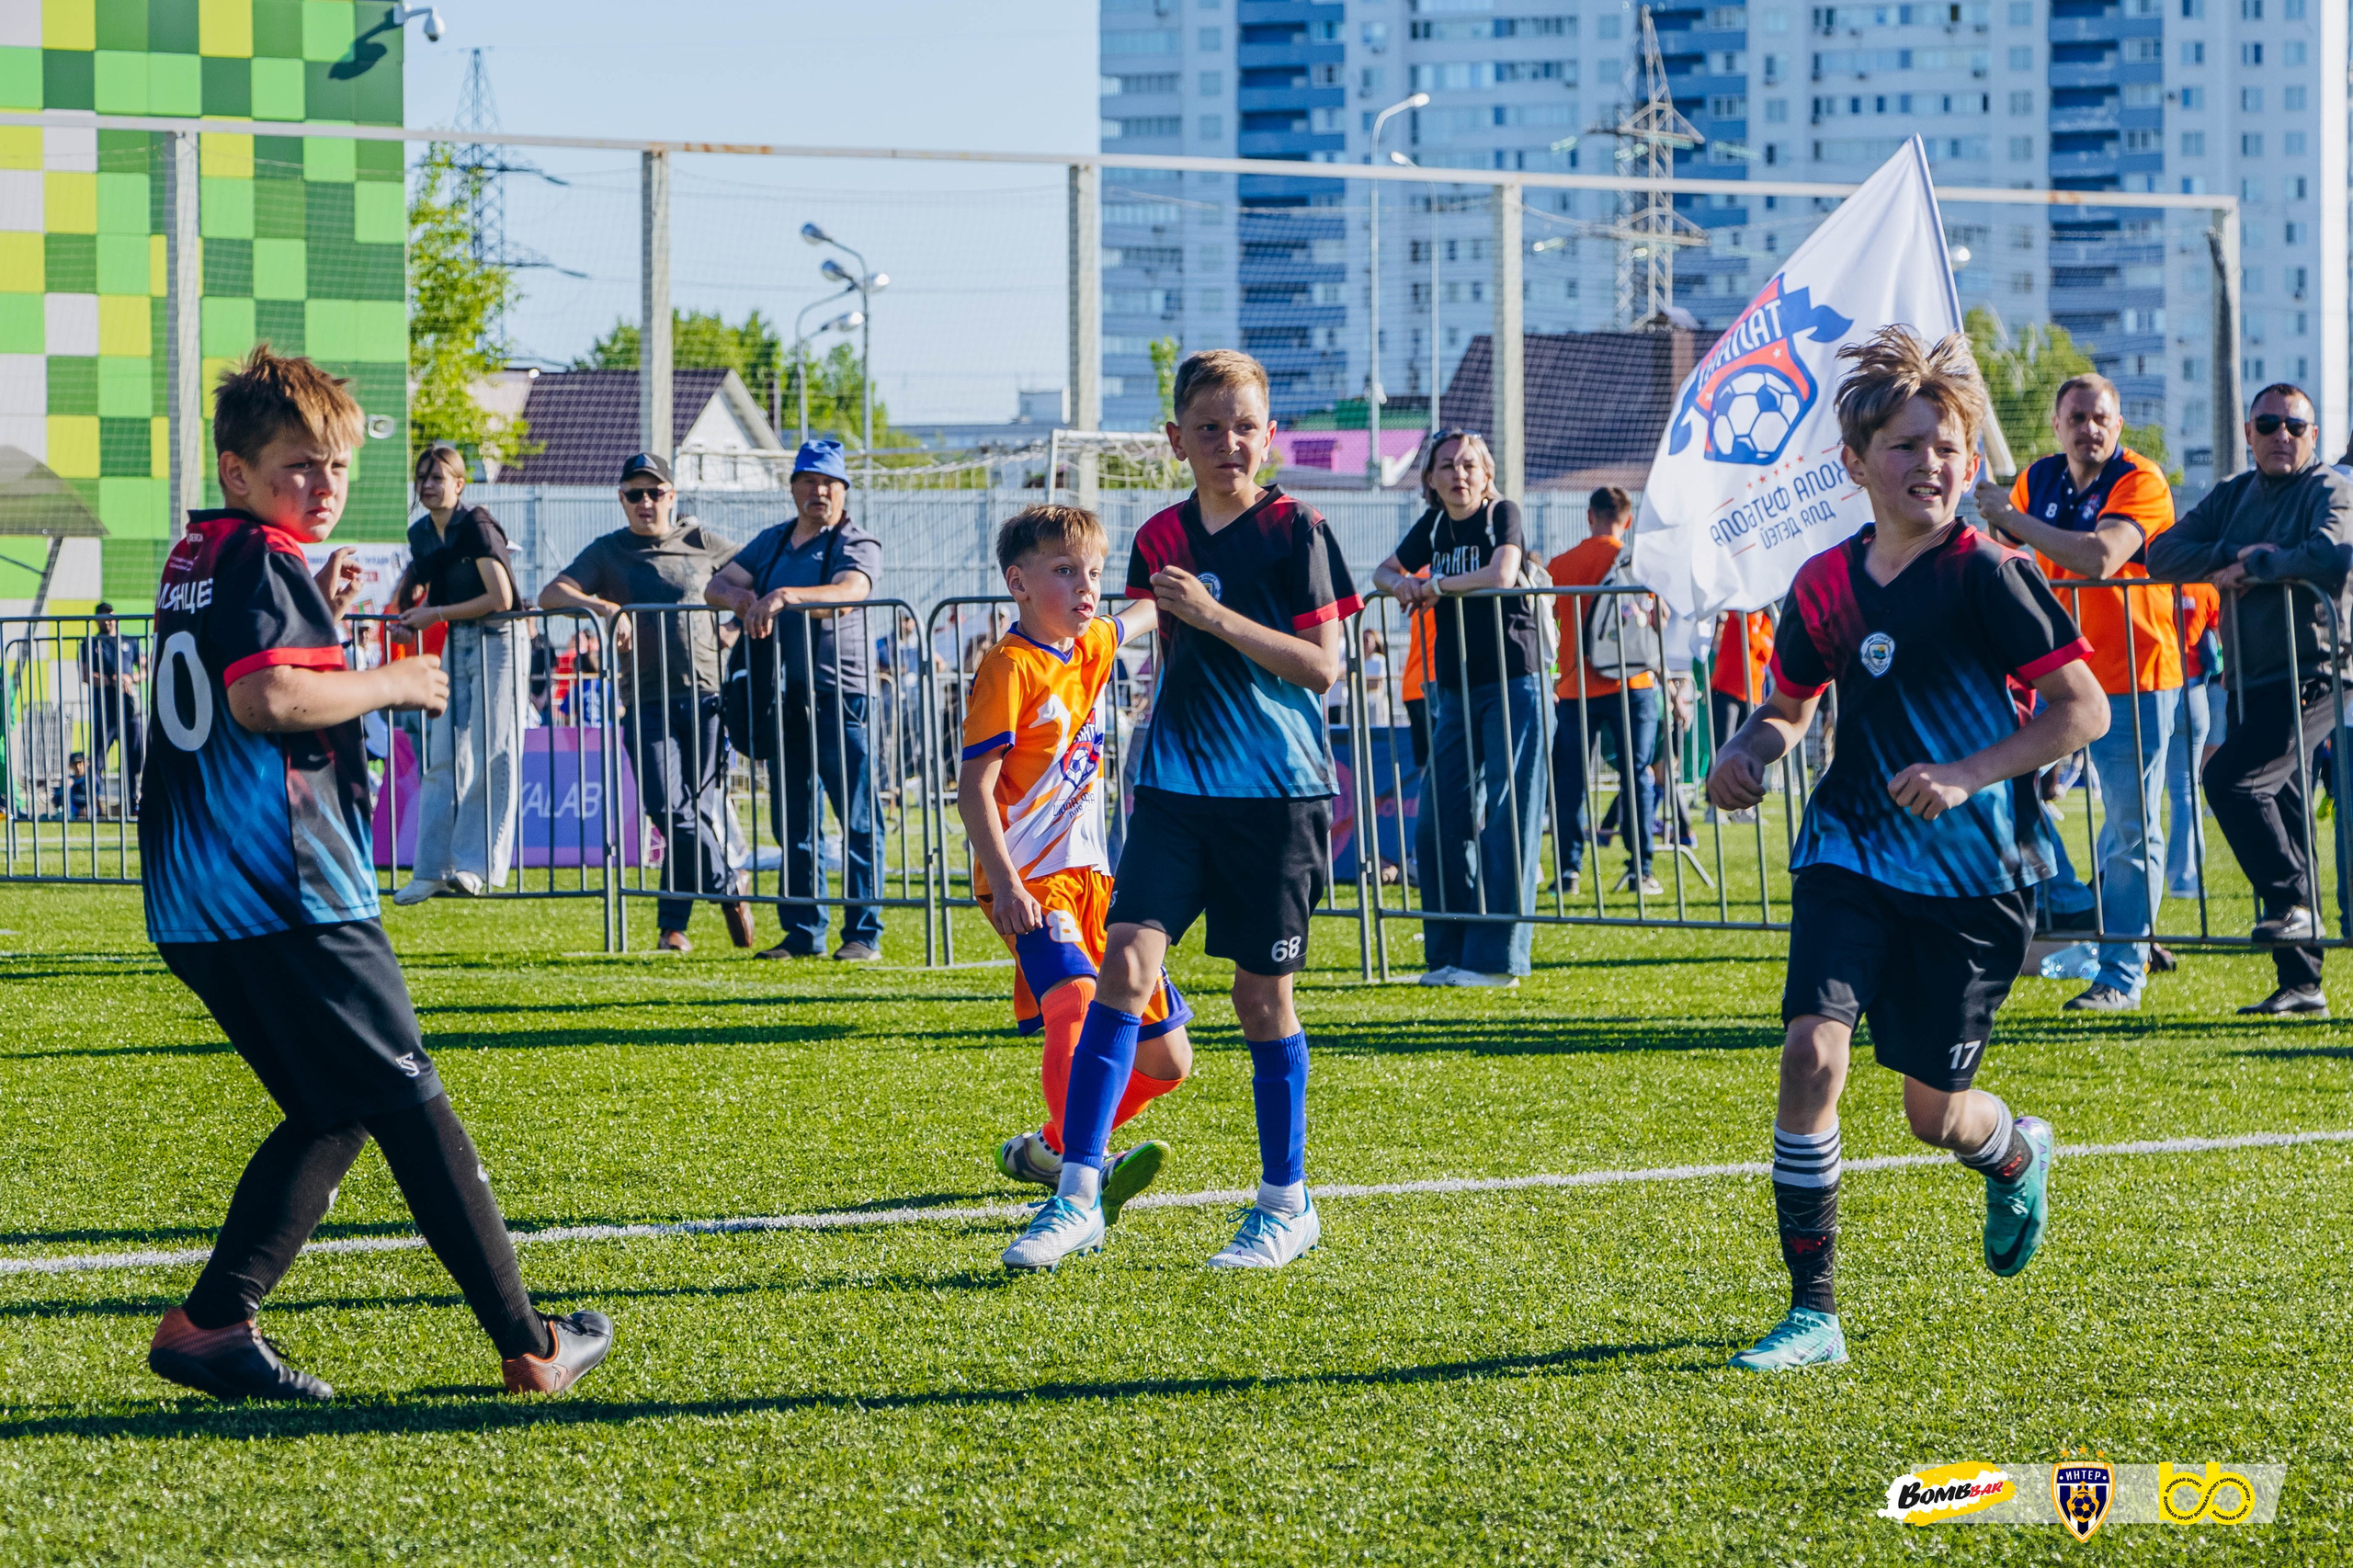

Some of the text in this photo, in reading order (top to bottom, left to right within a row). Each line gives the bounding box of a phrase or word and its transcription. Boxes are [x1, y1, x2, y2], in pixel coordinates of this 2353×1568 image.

[2045, 502, 2058, 518] 8
[1046, 909, 1083, 943] 8
[1271, 936, 1302, 962] 68
[1949, 1040, 1982, 1070] 17
